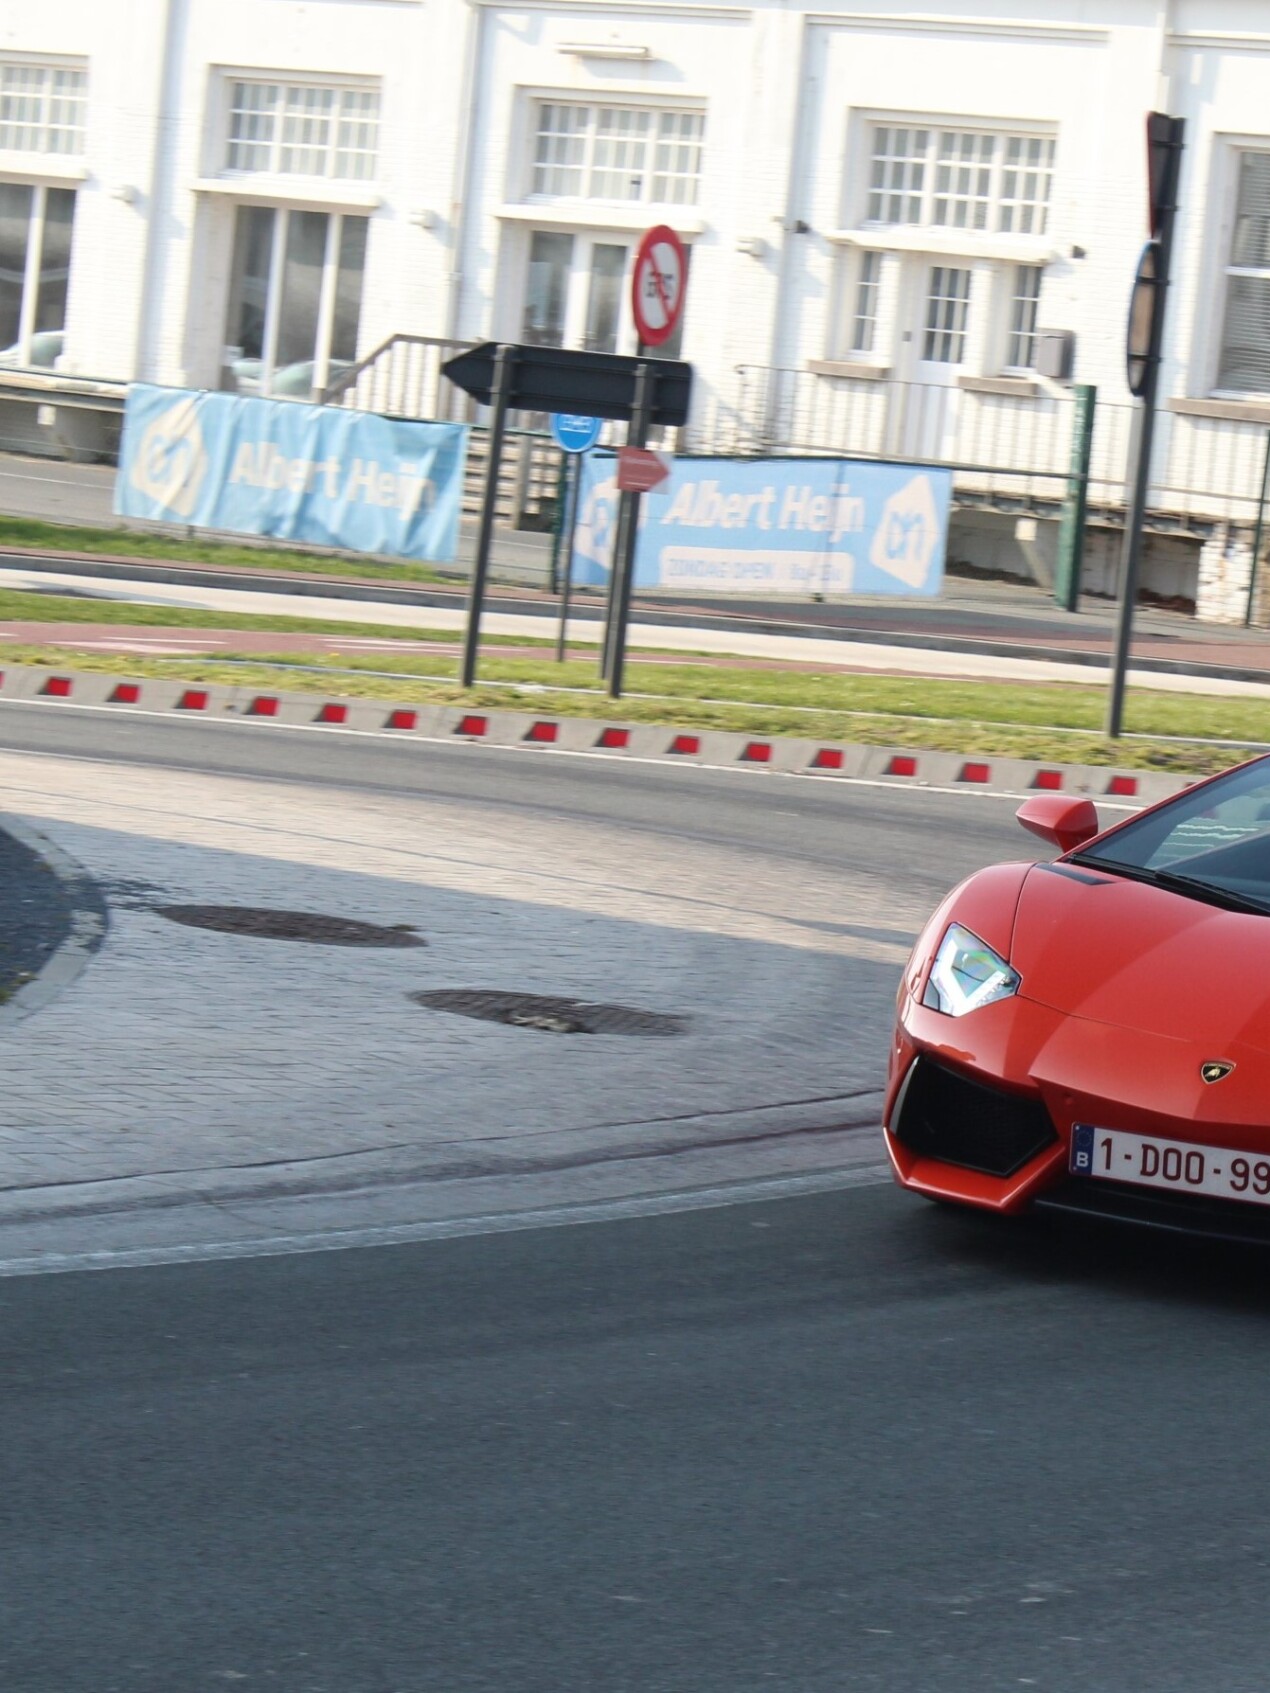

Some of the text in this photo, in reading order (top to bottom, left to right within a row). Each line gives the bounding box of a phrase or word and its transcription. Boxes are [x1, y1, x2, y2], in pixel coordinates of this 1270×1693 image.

[229, 441, 437, 521] Albert Heijn
[661, 480, 777, 531] Albert
[779, 484, 865, 542] Heijn
[1076, 1152, 1089, 1167] B
